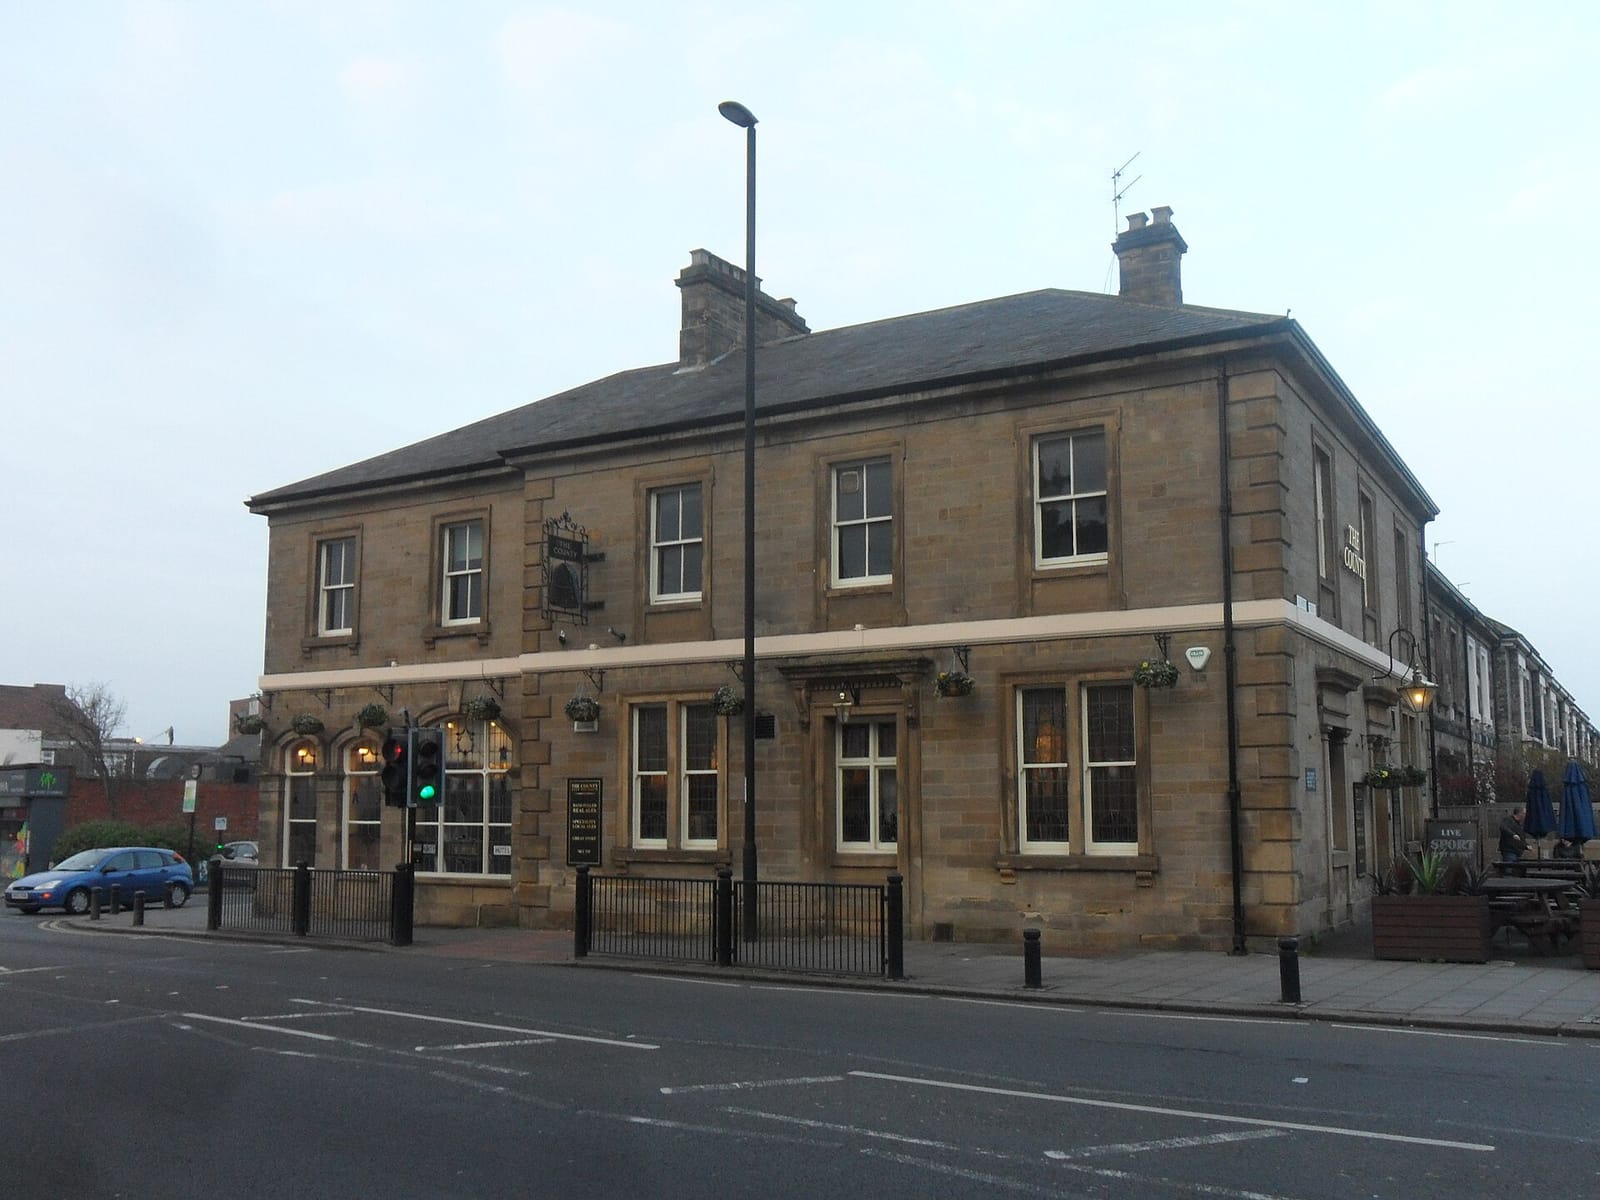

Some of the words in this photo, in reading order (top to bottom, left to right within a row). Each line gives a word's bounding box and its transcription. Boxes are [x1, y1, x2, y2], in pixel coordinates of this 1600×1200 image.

[1349, 524, 1359, 550] THE
[1345, 546, 1365, 579] COUNTY
[1430, 839, 1476, 850] SPORT
